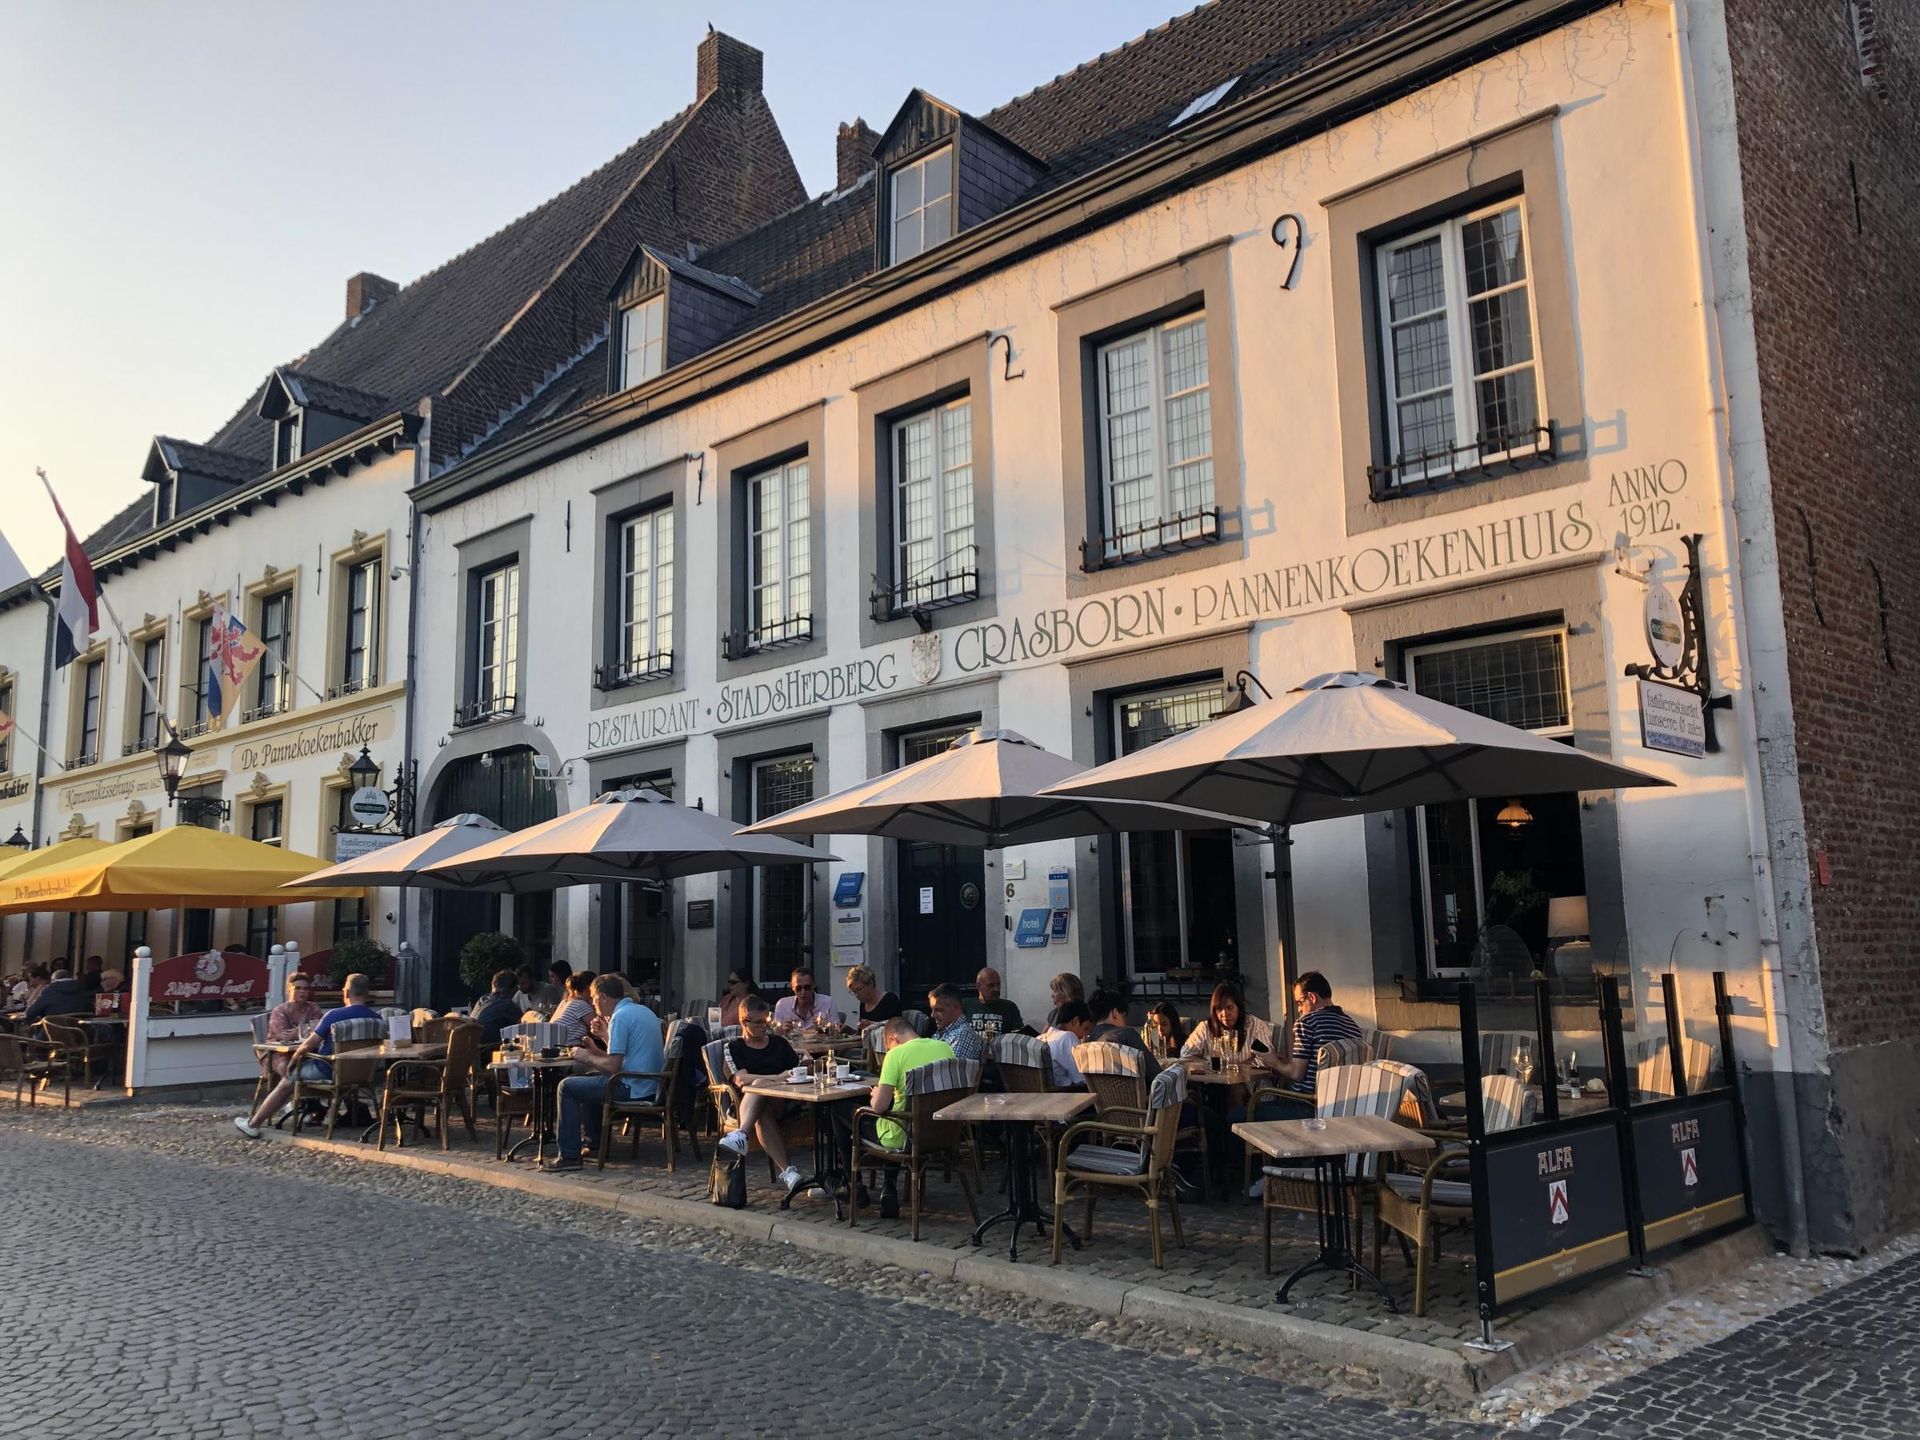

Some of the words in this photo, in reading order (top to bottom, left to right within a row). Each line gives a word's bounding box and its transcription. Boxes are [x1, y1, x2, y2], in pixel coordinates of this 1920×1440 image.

[1607, 457, 1688, 508] ANNO
[1619, 498, 1682, 538] 1912.
[586, 698, 700, 751] RESTAURANT
[954, 586, 1167, 673] CRASBORN
[1191, 500, 1594, 626] PANNENKOEKENHUIS
[241, 748, 259, 771] De
[261, 715, 379, 767] Pannekoekenbakker
[1005, 882, 1016, 898] 6
[1022, 917, 1040, 929] hotel
[1024, 936, 1044, 944] ANWB
[1670, 1118, 1700, 1144] ALFA
[1537, 1146, 1575, 1176] ALFA
